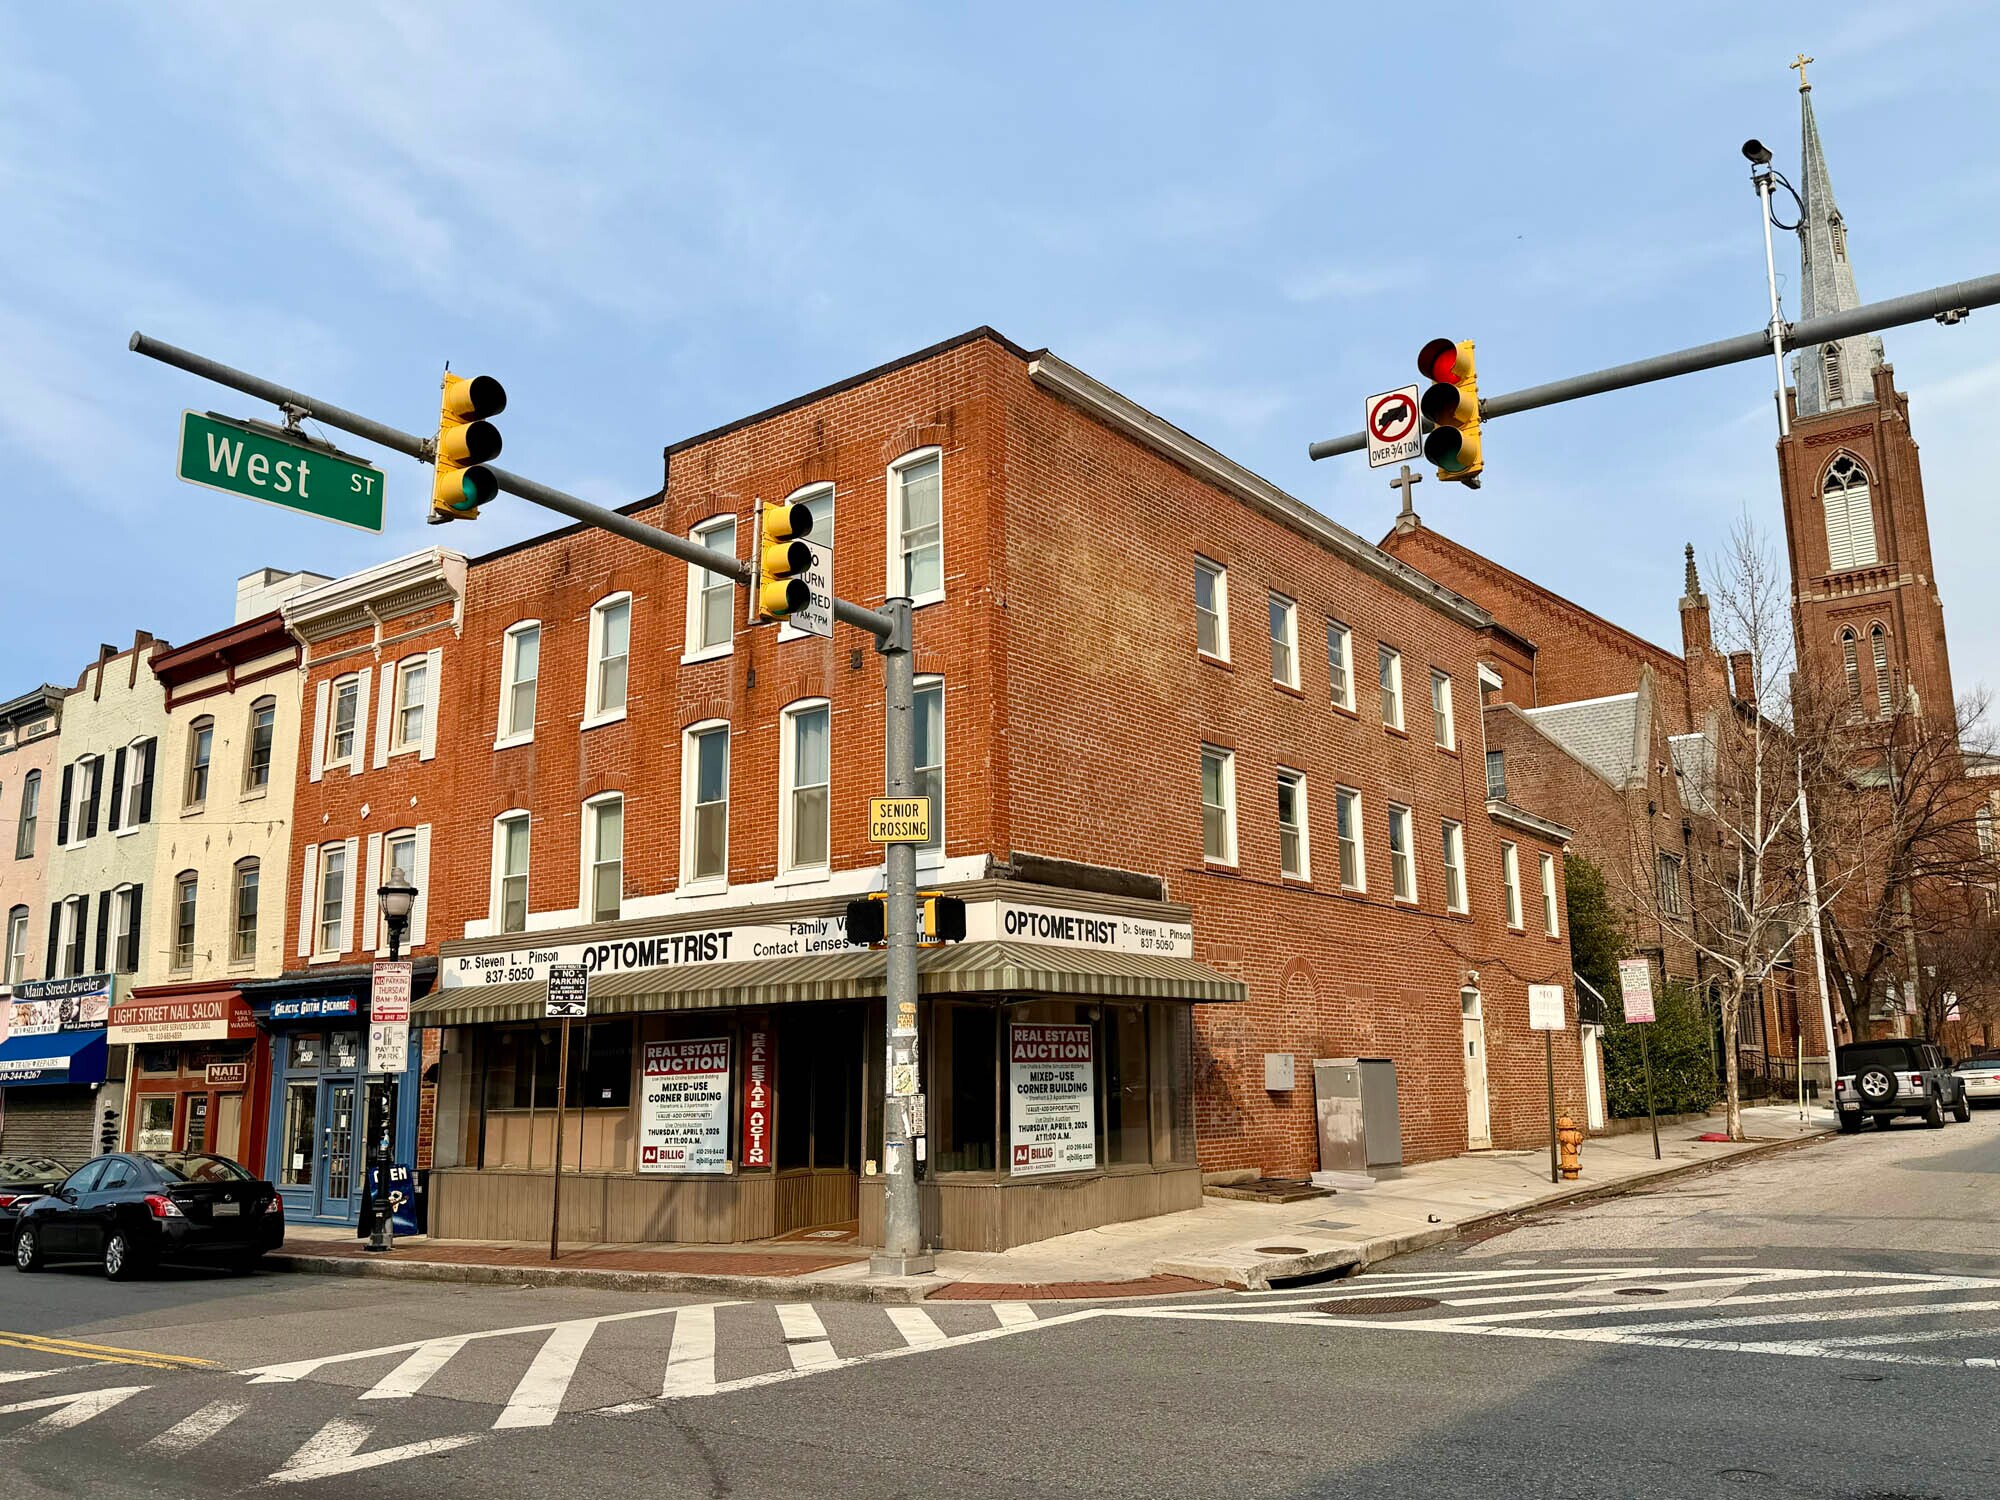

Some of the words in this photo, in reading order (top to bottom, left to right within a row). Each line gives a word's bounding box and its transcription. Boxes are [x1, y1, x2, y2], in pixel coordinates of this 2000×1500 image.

[1371, 447, 1391, 461] OVER
[1390, 442, 1403, 458] 3/4
[1404, 440, 1419, 453] TON
[206, 432, 311, 498] West
[350, 473, 375, 495] ST
[811, 592, 831, 610] RED
[880, 803, 919, 818] SENIOR
[873, 821, 926, 836] CROSSING
[789, 919, 828, 936] Family
[1004, 910, 1118, 944] OPTOMETRIST
[1122, 923, 1132, 935] Dr.
[1134, 925, 1157, 937] Steven
[1159, 928, 1167, 939] L.
[1169, 929, 1192, 941] Pinson
[582, 931, 733, 972] OPTOMETRIST
[753, 939, 798, 957] Contact
[805, 937, 849, 953] Lenses
[375, 963, 383, 971] NO
[460, 958, 472, 971] Dr.
[475, 956, 505, 969] Steven
[511, 953, 522, 966] L.
[529, 951, 559, 964] Pinson
[24, 984, 44, 999] Main
[45, 982, 68, 997] Street
[68, 977, 100, 994] Jeweler
[375, 977, 384, 985] NO
[385, 977, 408, 985] PARKING
[550, 977, 586, 985] PARKING
[379, 986, 406, 994] THURSDAY
[113, 1008, 138, 1024] LIGHT
[138, 1006, 169, 1022] STREET
[169, 1004, 190, 1020] NAIL
[192, 1002, 222, 1019] SALON
[1014, 1030, 1043, 1042] REAL
[1045, 1030, 1089, 1042] ESTATE
[647, 1046, 678, 1058] REAL
[680, 1043, 726, 1056] ESTATE
[751, 1032, 767, 1062] REAL
[1014, 1044, 1089, 1059] AUCTION
[211, 1066, 242, 1077] NAIL
[646, 1056, 726, 1073] AUCTION
[0, 1070, 41, 1080] 10-244-8267
[1030, 1071, 1075, 1082] MIXED-USE
[661, 1081, 708, 1092] MIXED-USE
[750, 1064, 766, 1109] ESTATE
[1017, 1084, 1048, 1094] CORNER
[1049, 1083, 1088, 1093] BUILDING
[648, 1093, 682, 1103] CORNER
[684, 1092, 722, 1102] BUILDING
[1018, 1124, 1050, 1133] THURSDAY,
[1050, 1122, 1067, 1130] APRIL
[1074, 1121, 1088, 1129] 2026
[154, 1134, 169, 1145] Salon
[749, 1111, 765, 1163] AUCTION
[1043, 1133, 1057, 1141] 11:00
[1057, 1132, 1072, 1140] A.M.
[644, 1149, 656, 1160] AJ
[659, 1150, 684, 1160] BILLIG
[1016, 1149, 1028, 1162] AJ
[1031, 1147, 1053, 1160] BILLIG
[1066, 1153, 1093, 1163] ajbillig.com
